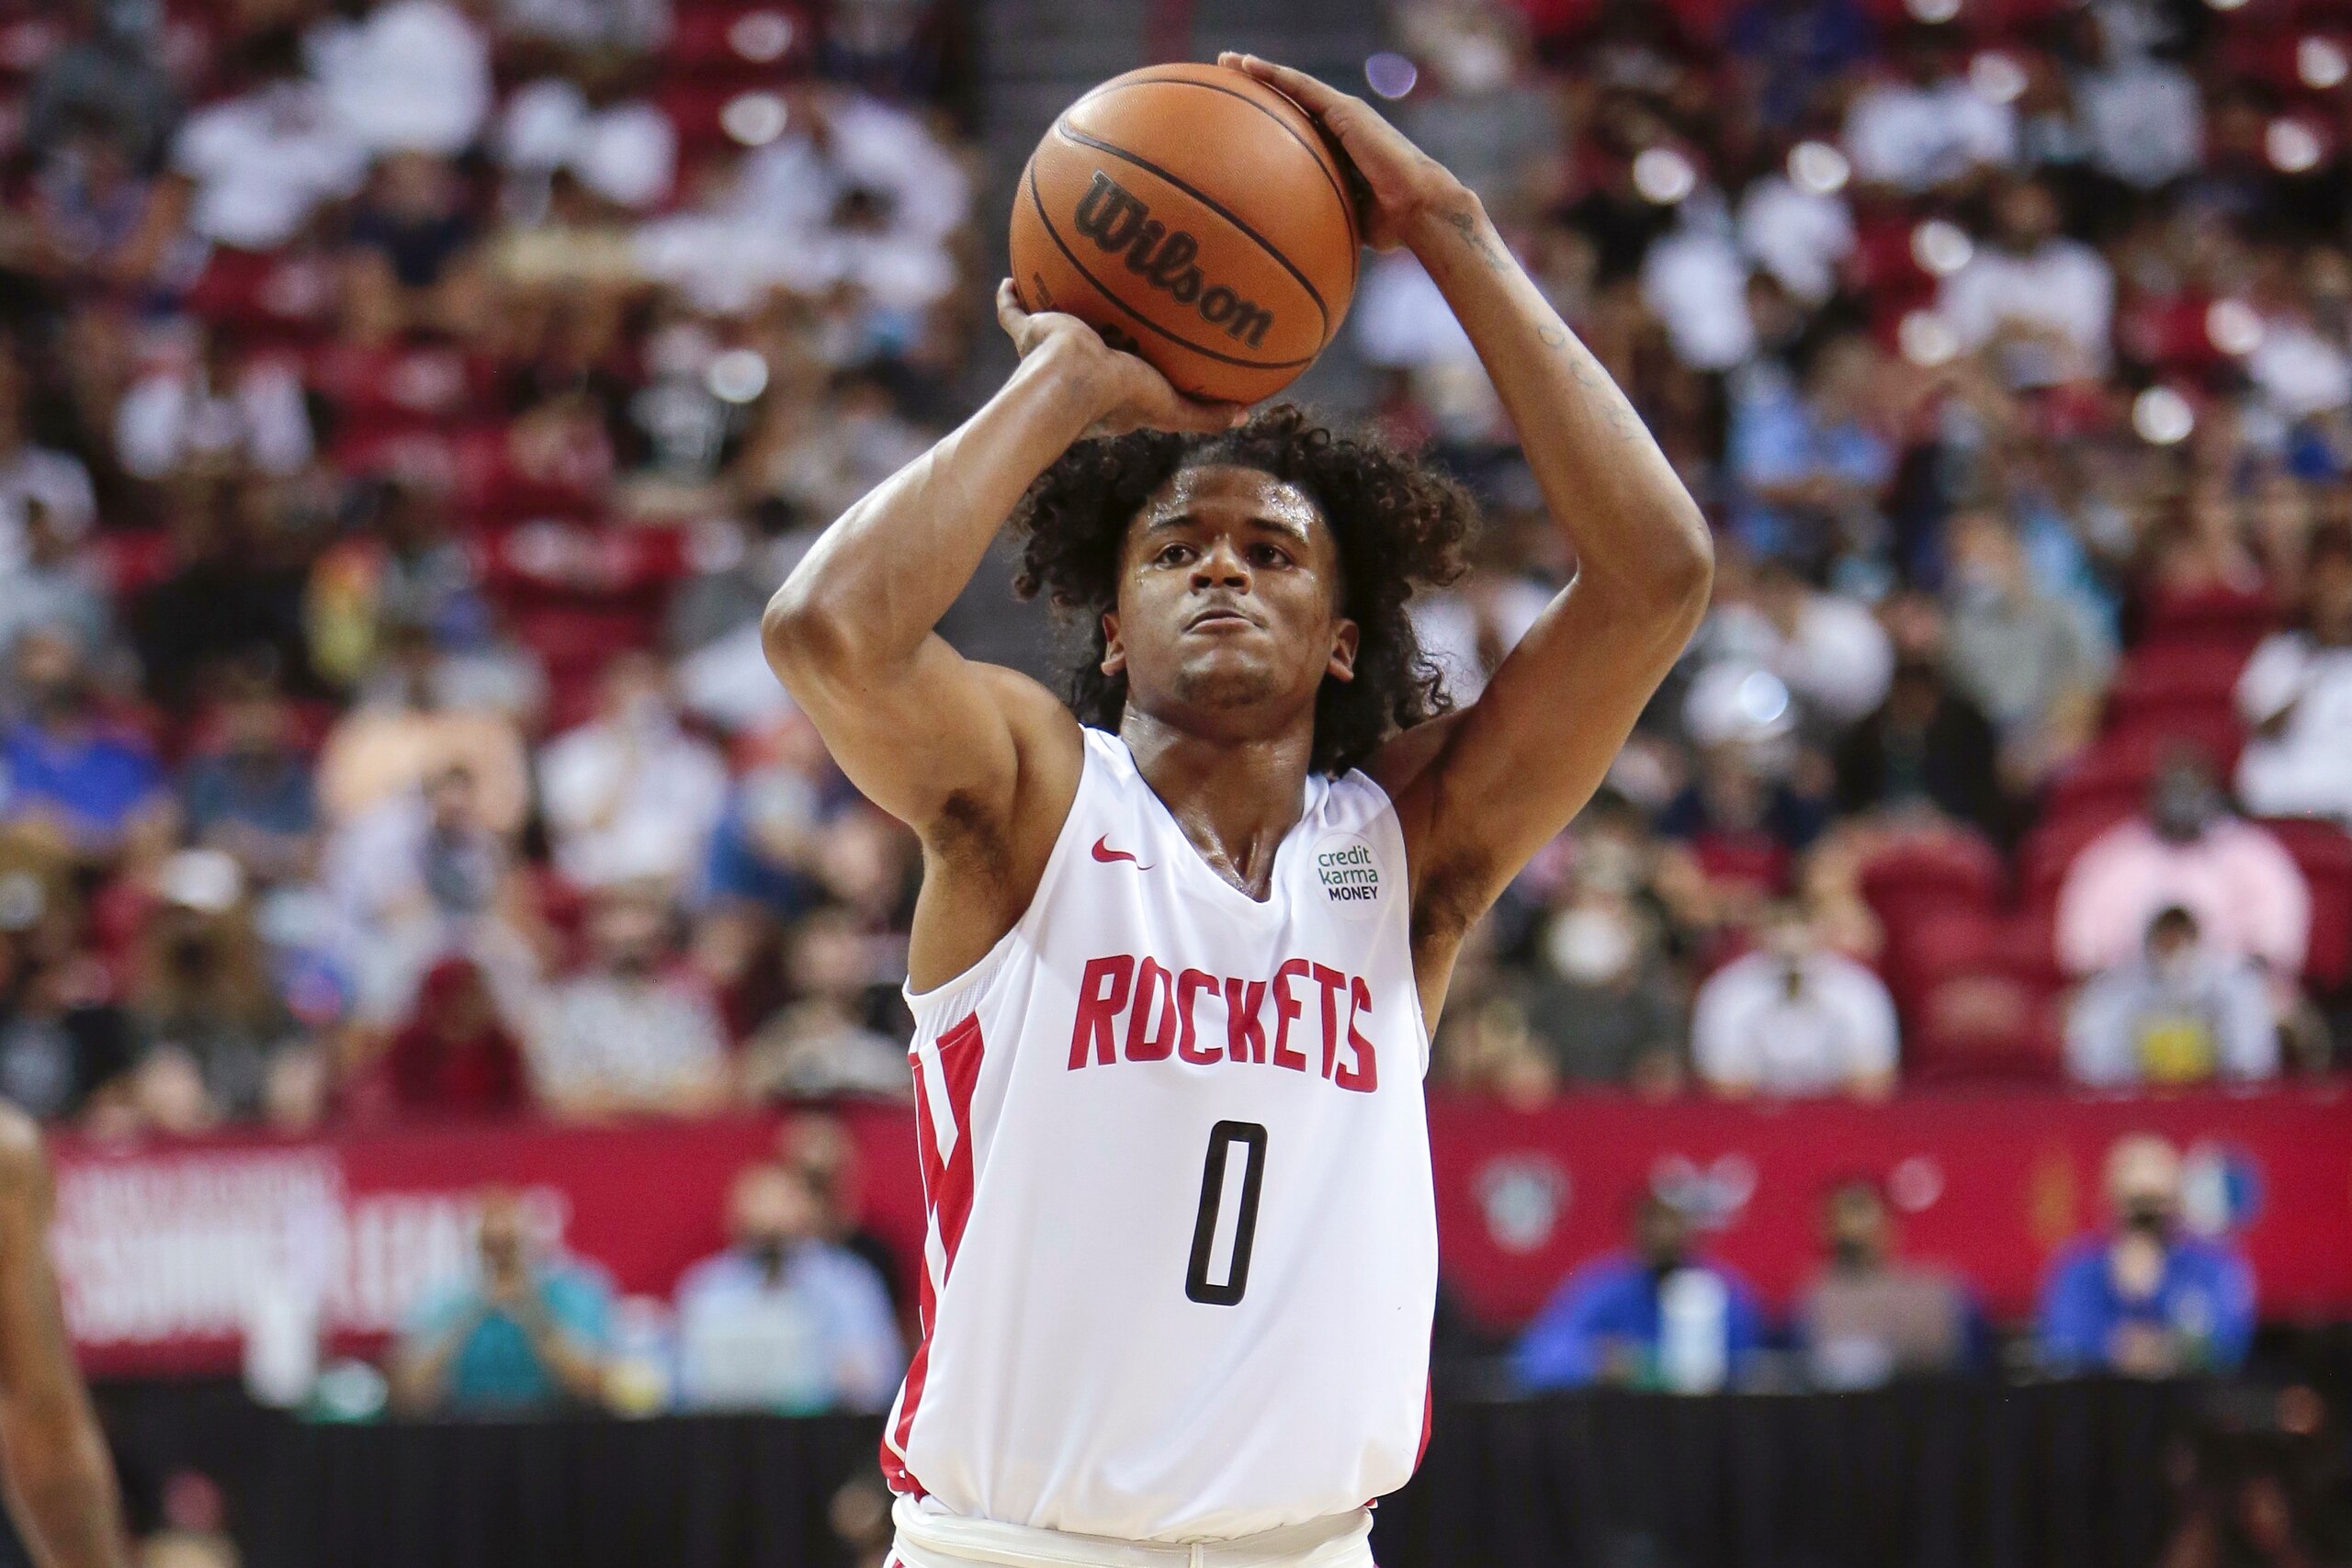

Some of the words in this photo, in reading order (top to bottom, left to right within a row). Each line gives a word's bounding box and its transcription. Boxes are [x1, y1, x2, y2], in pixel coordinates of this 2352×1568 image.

[1075, 170, 1273, 348] Wilson
[1317, 868, 1378, 885] karma
[1318, 845, 1372, 867] credit
[1329, 886, 1378, 901] MONEY
[1068, 955, 1377, 1093] ROCKETS
[1186, 1121, 1267, 1306] 0
